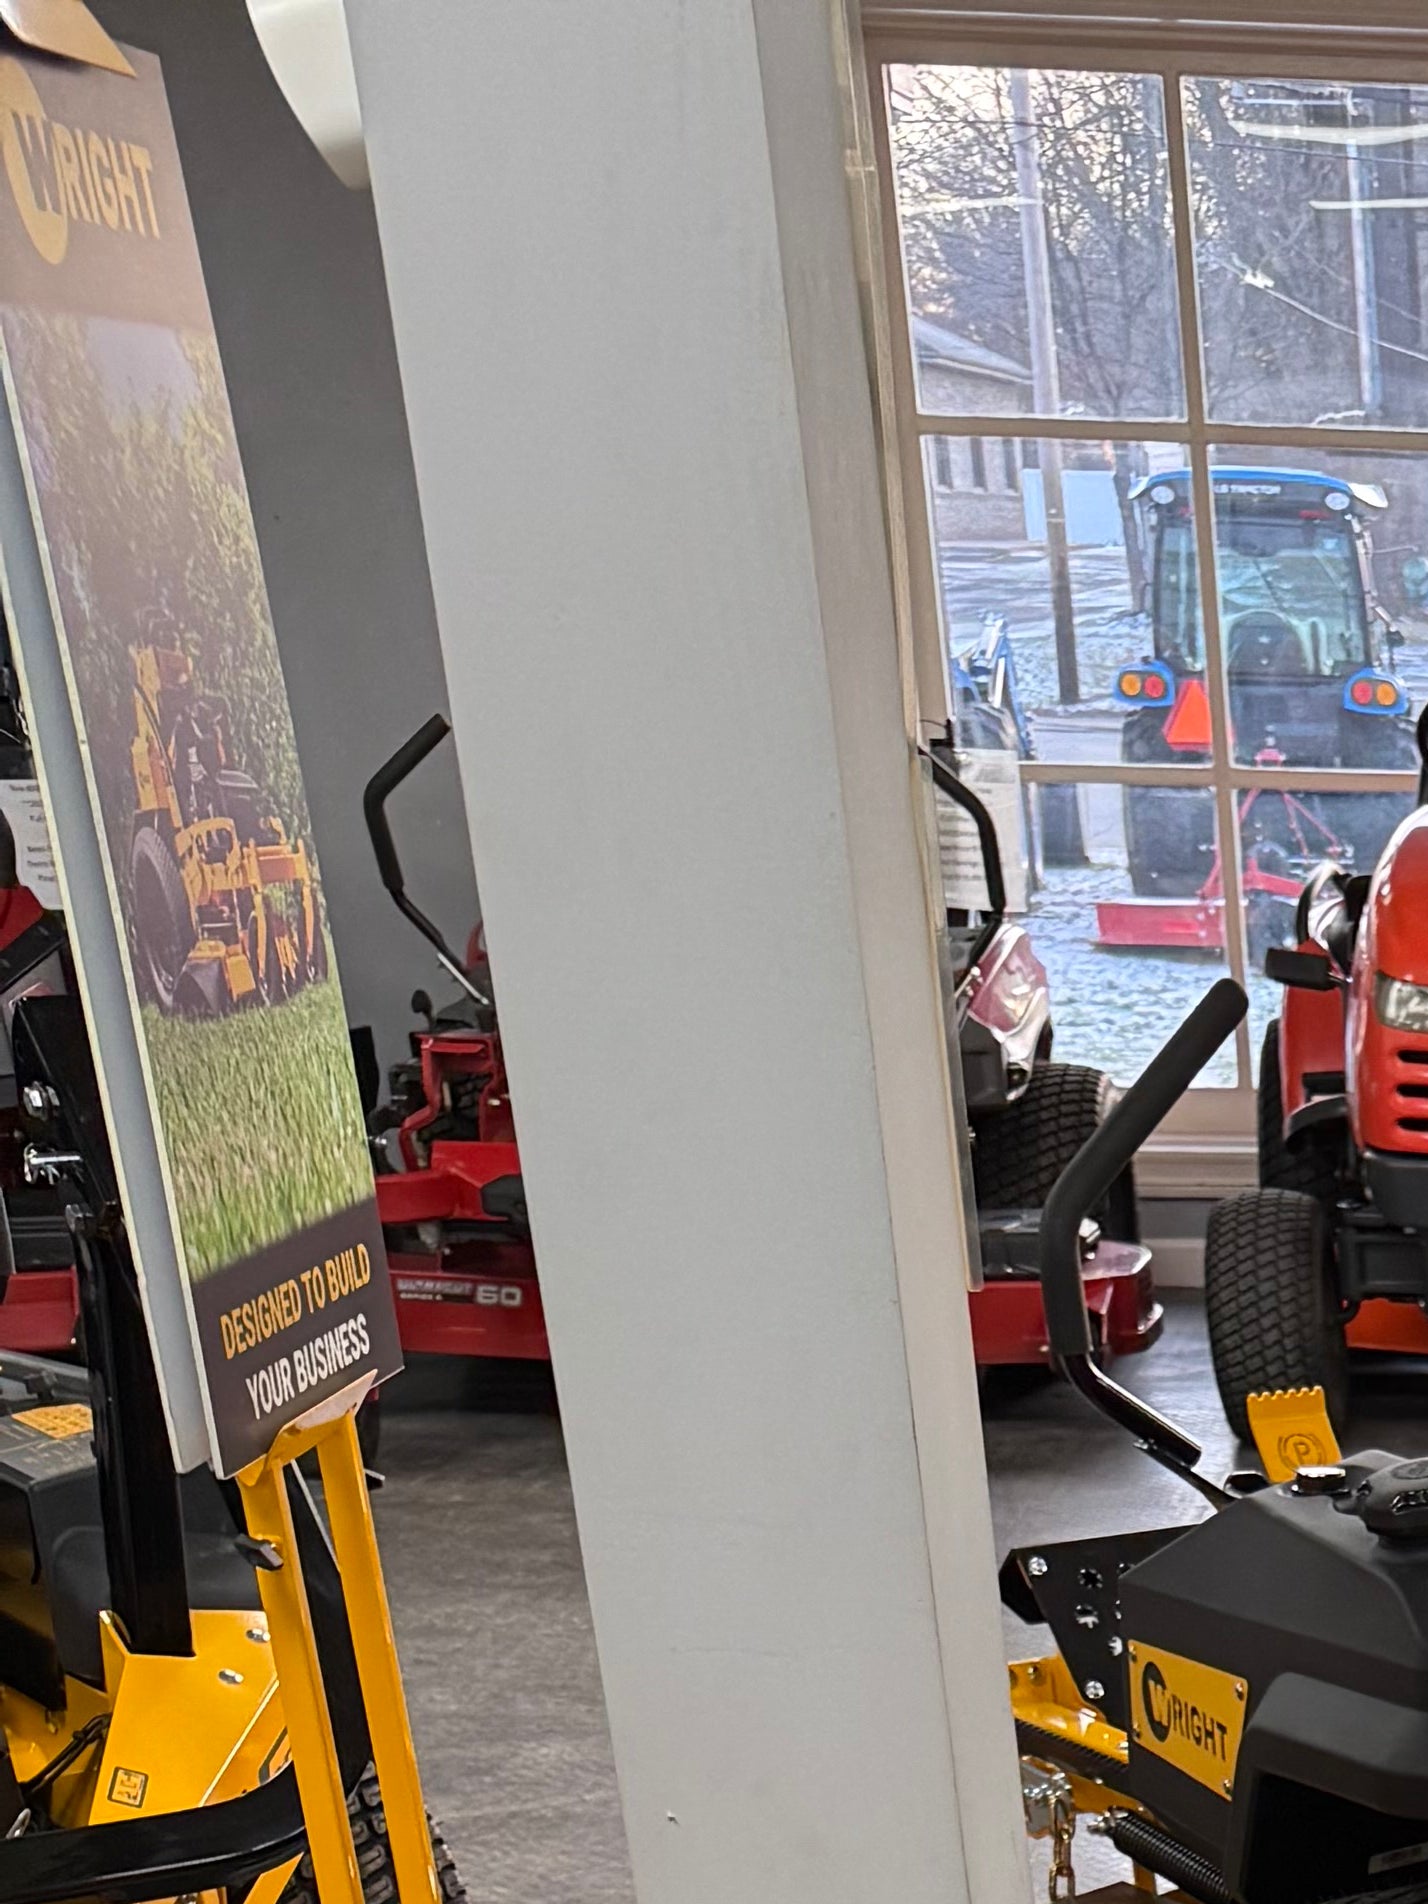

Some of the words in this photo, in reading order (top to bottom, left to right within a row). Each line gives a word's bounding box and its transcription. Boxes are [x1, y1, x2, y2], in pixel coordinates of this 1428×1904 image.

[11, 111, 160, 240] WRIGHT
[219, 1278, 302, 1360] DESIGNED
[300, 1266, 325, 1314] TO
[325, 1243, 371, 1302] BUILD
[476, 1284, 522, 1307] 60
[245, 1357, 295, 1420] YOUR
[293, 1313, 370, 1393] BUSINESS
[1148, 1679, 1228, 1762] WRIGHT
